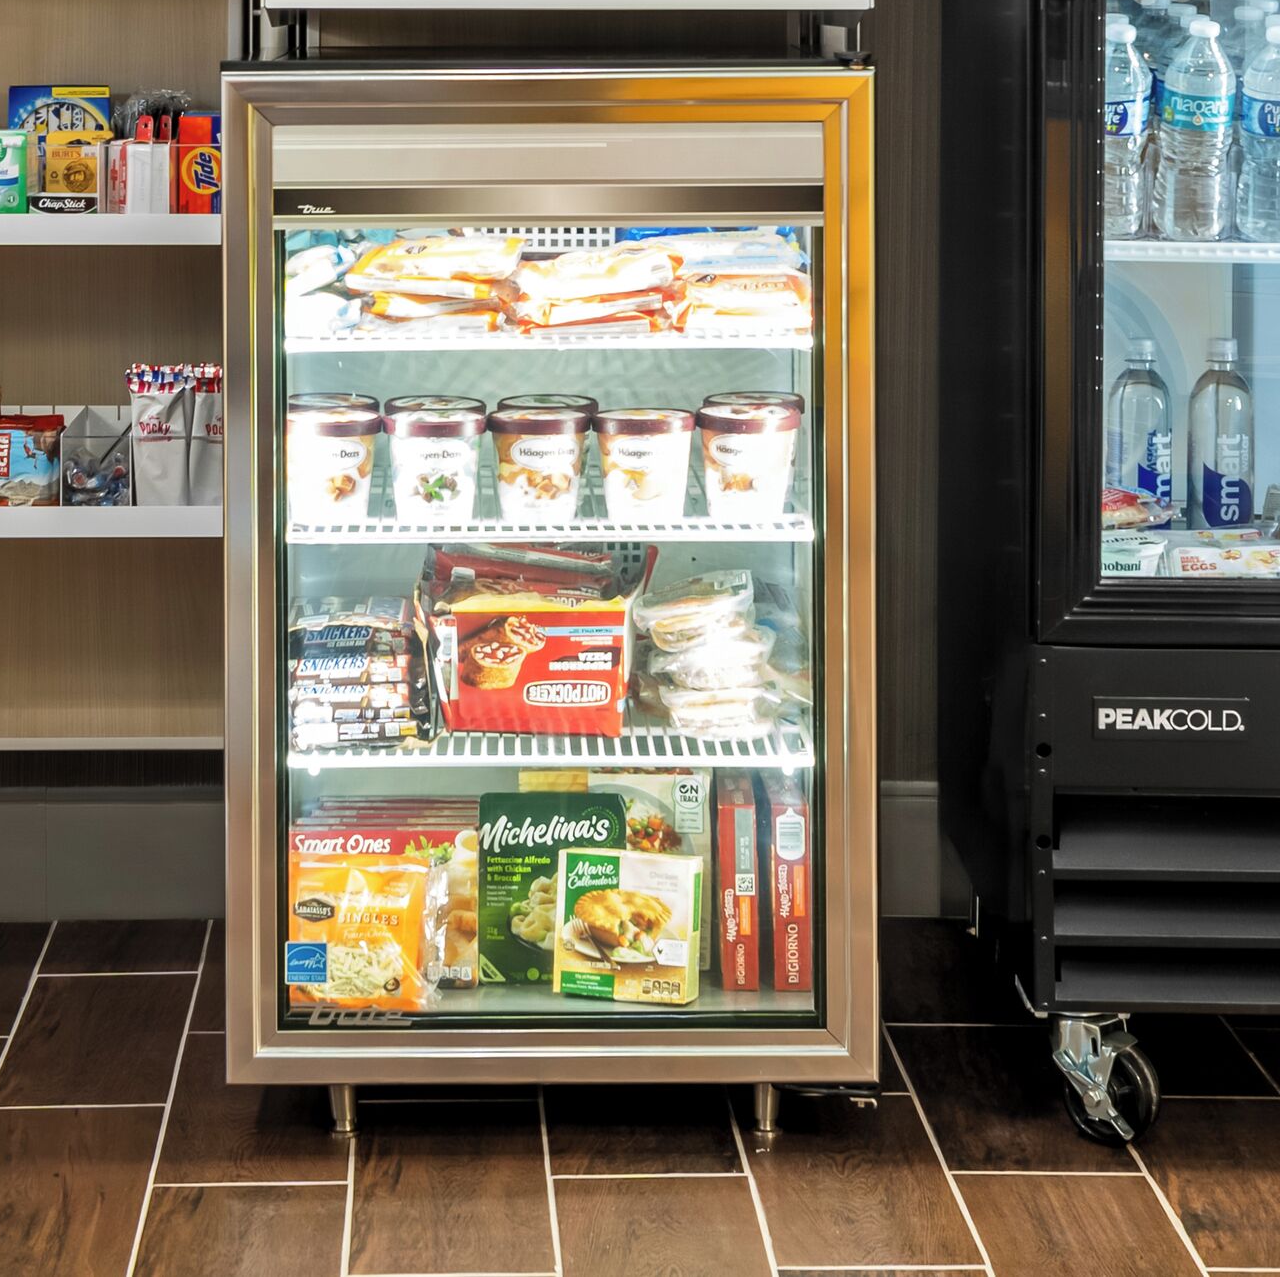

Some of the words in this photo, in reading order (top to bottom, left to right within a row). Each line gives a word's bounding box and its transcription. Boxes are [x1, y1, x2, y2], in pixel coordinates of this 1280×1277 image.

[1171, 96, 1229, 118] niagara
[51, 149, 81, 158] BURT'S
[193, 151, 219, 189] Tide
[38, 197, 87, 211] ChapStick
[139, 422, 170, 435] Pocky
[1240, 433, 1250, 473] water
[1219, 433, 1241, 522] smart
[1182, 562, 1217, 572] EGGS
[304, 626, 371, 641] SNICKERS
[302, 656, 368, 673] SNICKERS
[680, 795, 699, 803] TRACK
[479, 815, 611, 853] Michelina's
[295, 835, 343, 853] Smart
[347, 835, 391, 854] Ones
[486, 856, 522, 865] Fettuccine
[524, 856, 551, 865] Alfredo
[487, 866, 503, 874] with
[504, 865, 531, 874] Chicken
[569, 861, 615, 877] Marie
[494, 874, 521, 883] Broccoli
[568, 874, 618, 889] Callender's
[337, 913, 399, 926] SINGLES
[787, 923, 799, 984] DIGIORNO
